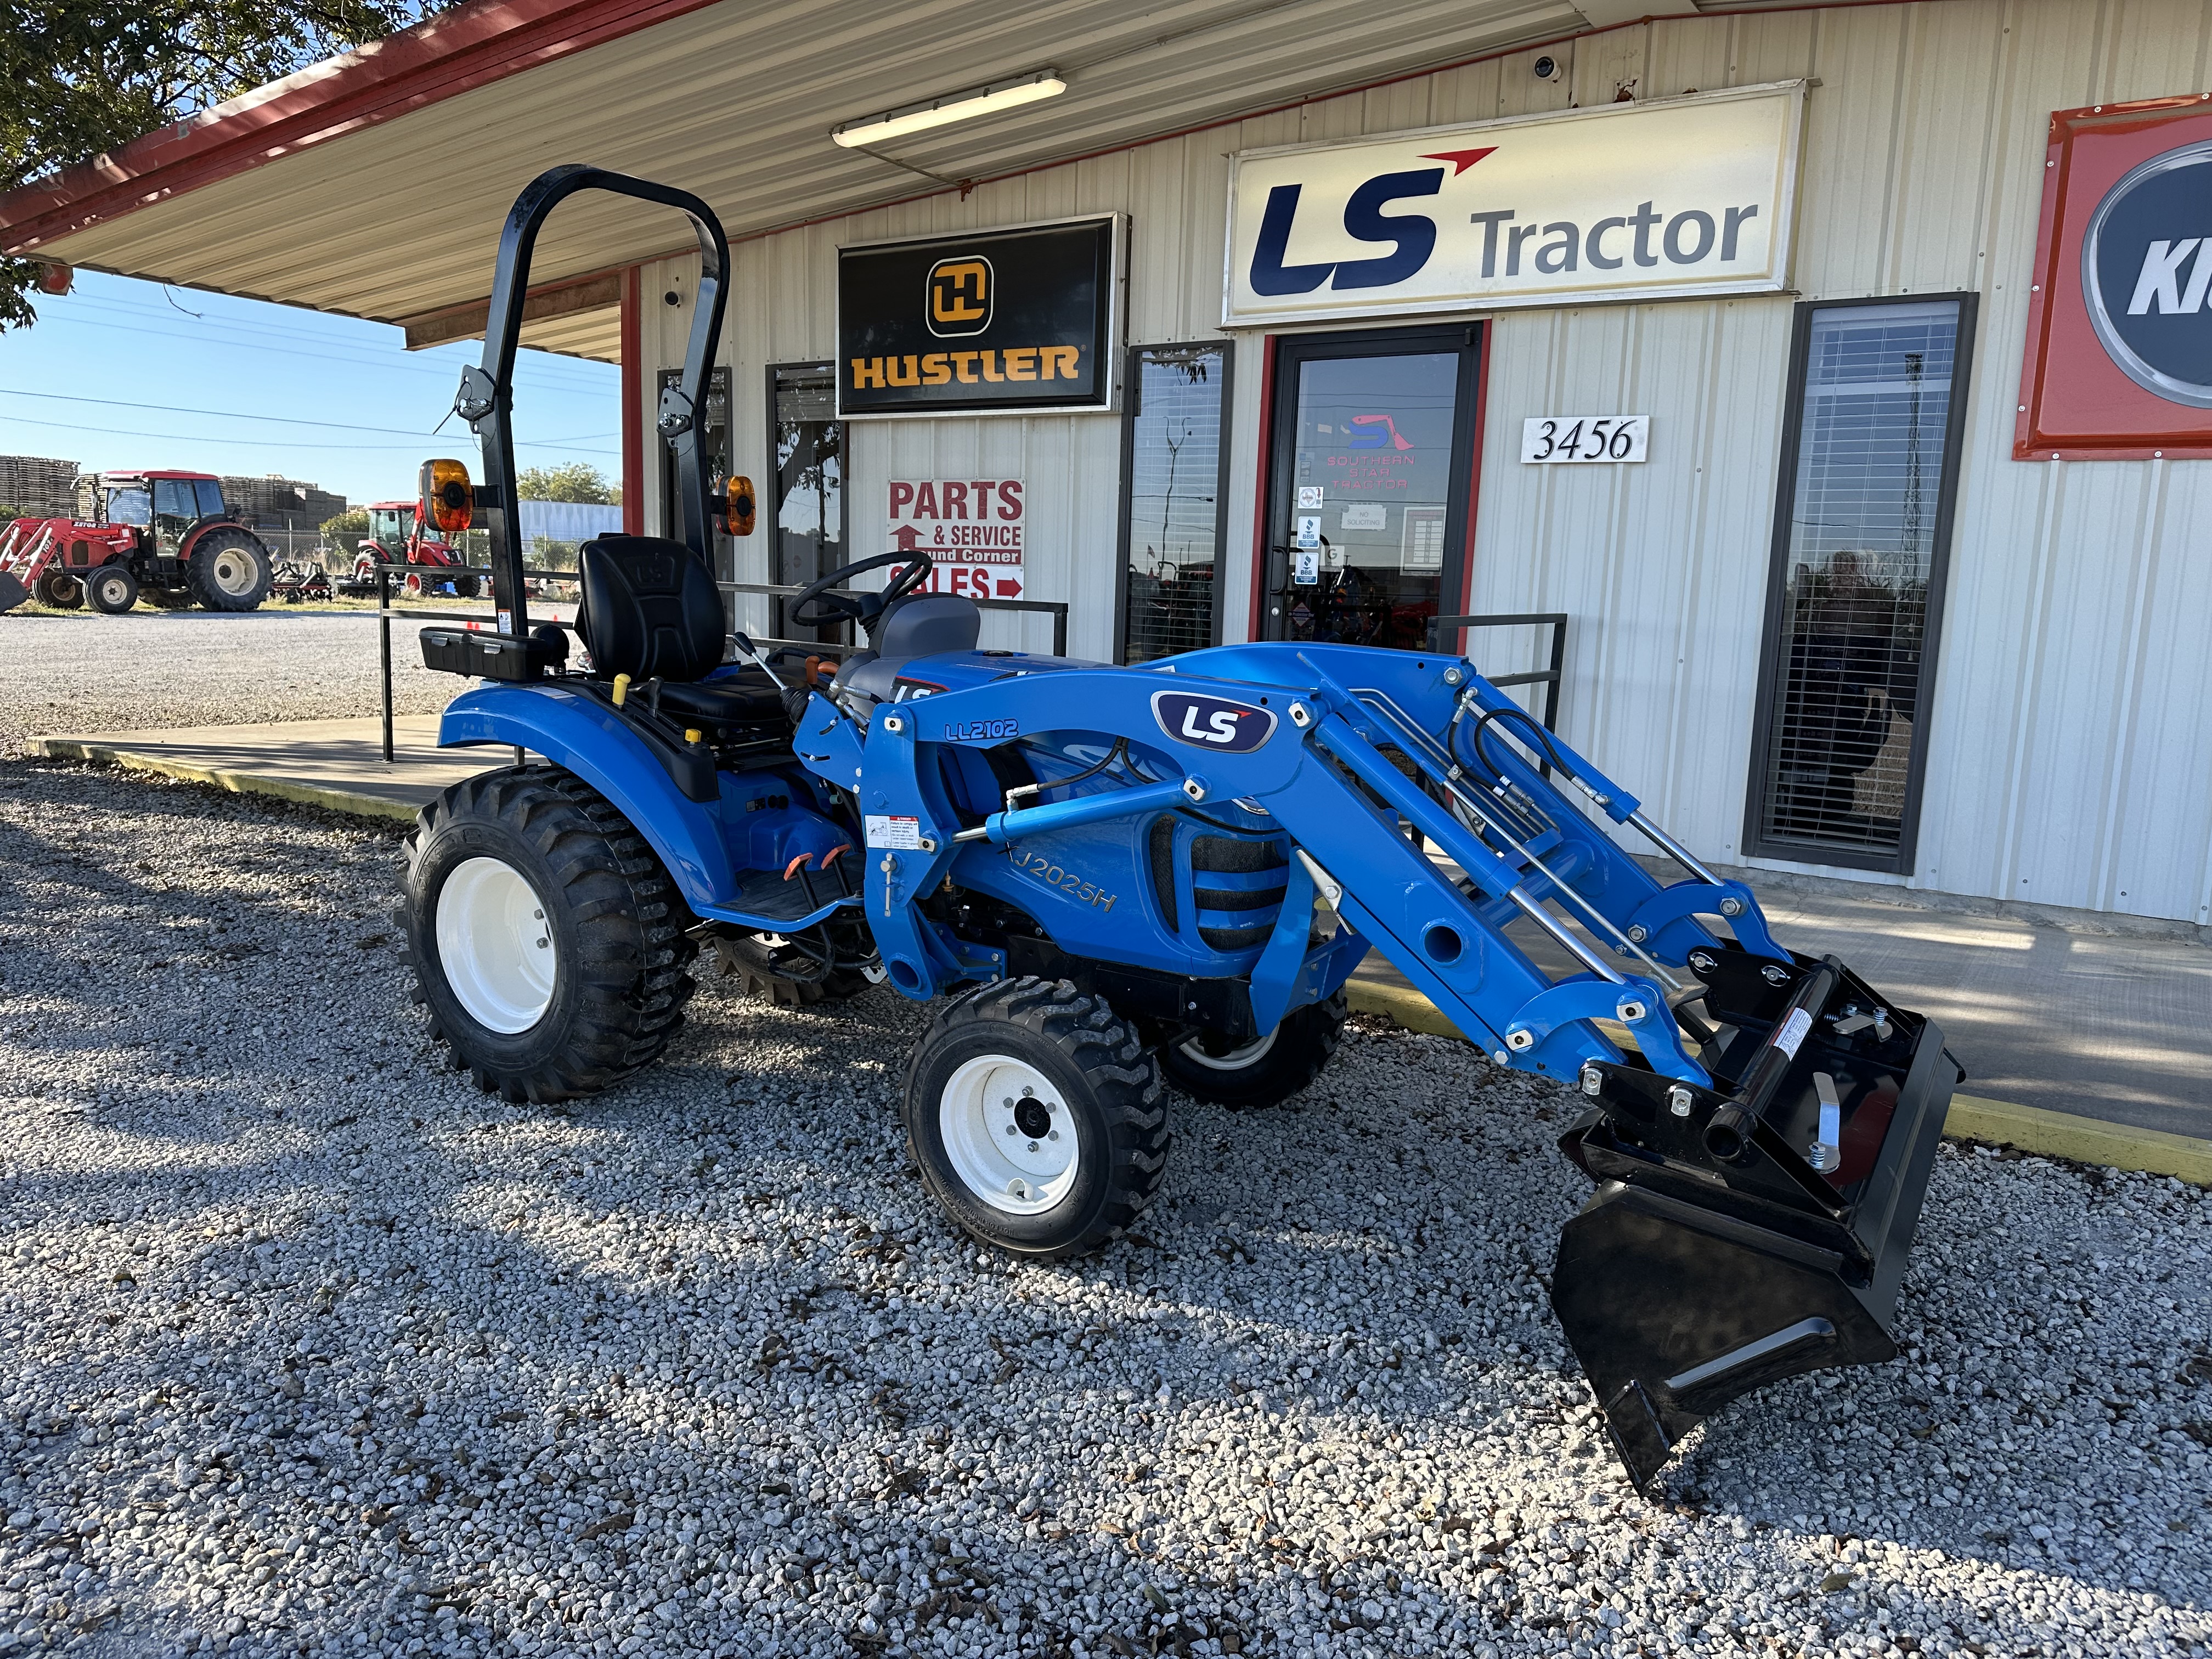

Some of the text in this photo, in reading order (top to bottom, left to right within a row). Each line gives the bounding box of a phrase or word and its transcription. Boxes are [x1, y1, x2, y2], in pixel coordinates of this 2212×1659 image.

[1250, 167, 1758, 296] LS Tractor
[2126, 238, 2212, 314] KI
[850, 345, 1080, 389] HUSTLER
[1533, 419, 1637, 459] 3456
[1328, 455, 1415, 466] SOUTHERN
[1350, 468, 1391, 478] STAR
[890, 481, 1023, 521] PARTS
[1331, 479, 1408, 489] TRACTOR
[934, 525, 1021, 546] & SERVICE
[962, 549, 1018, 563] Corner
[945, 718, 1019, 742] LL2102
[1182, 706, 1239, 743] LS
[997, 842, 1118, 913] XJ2025H
